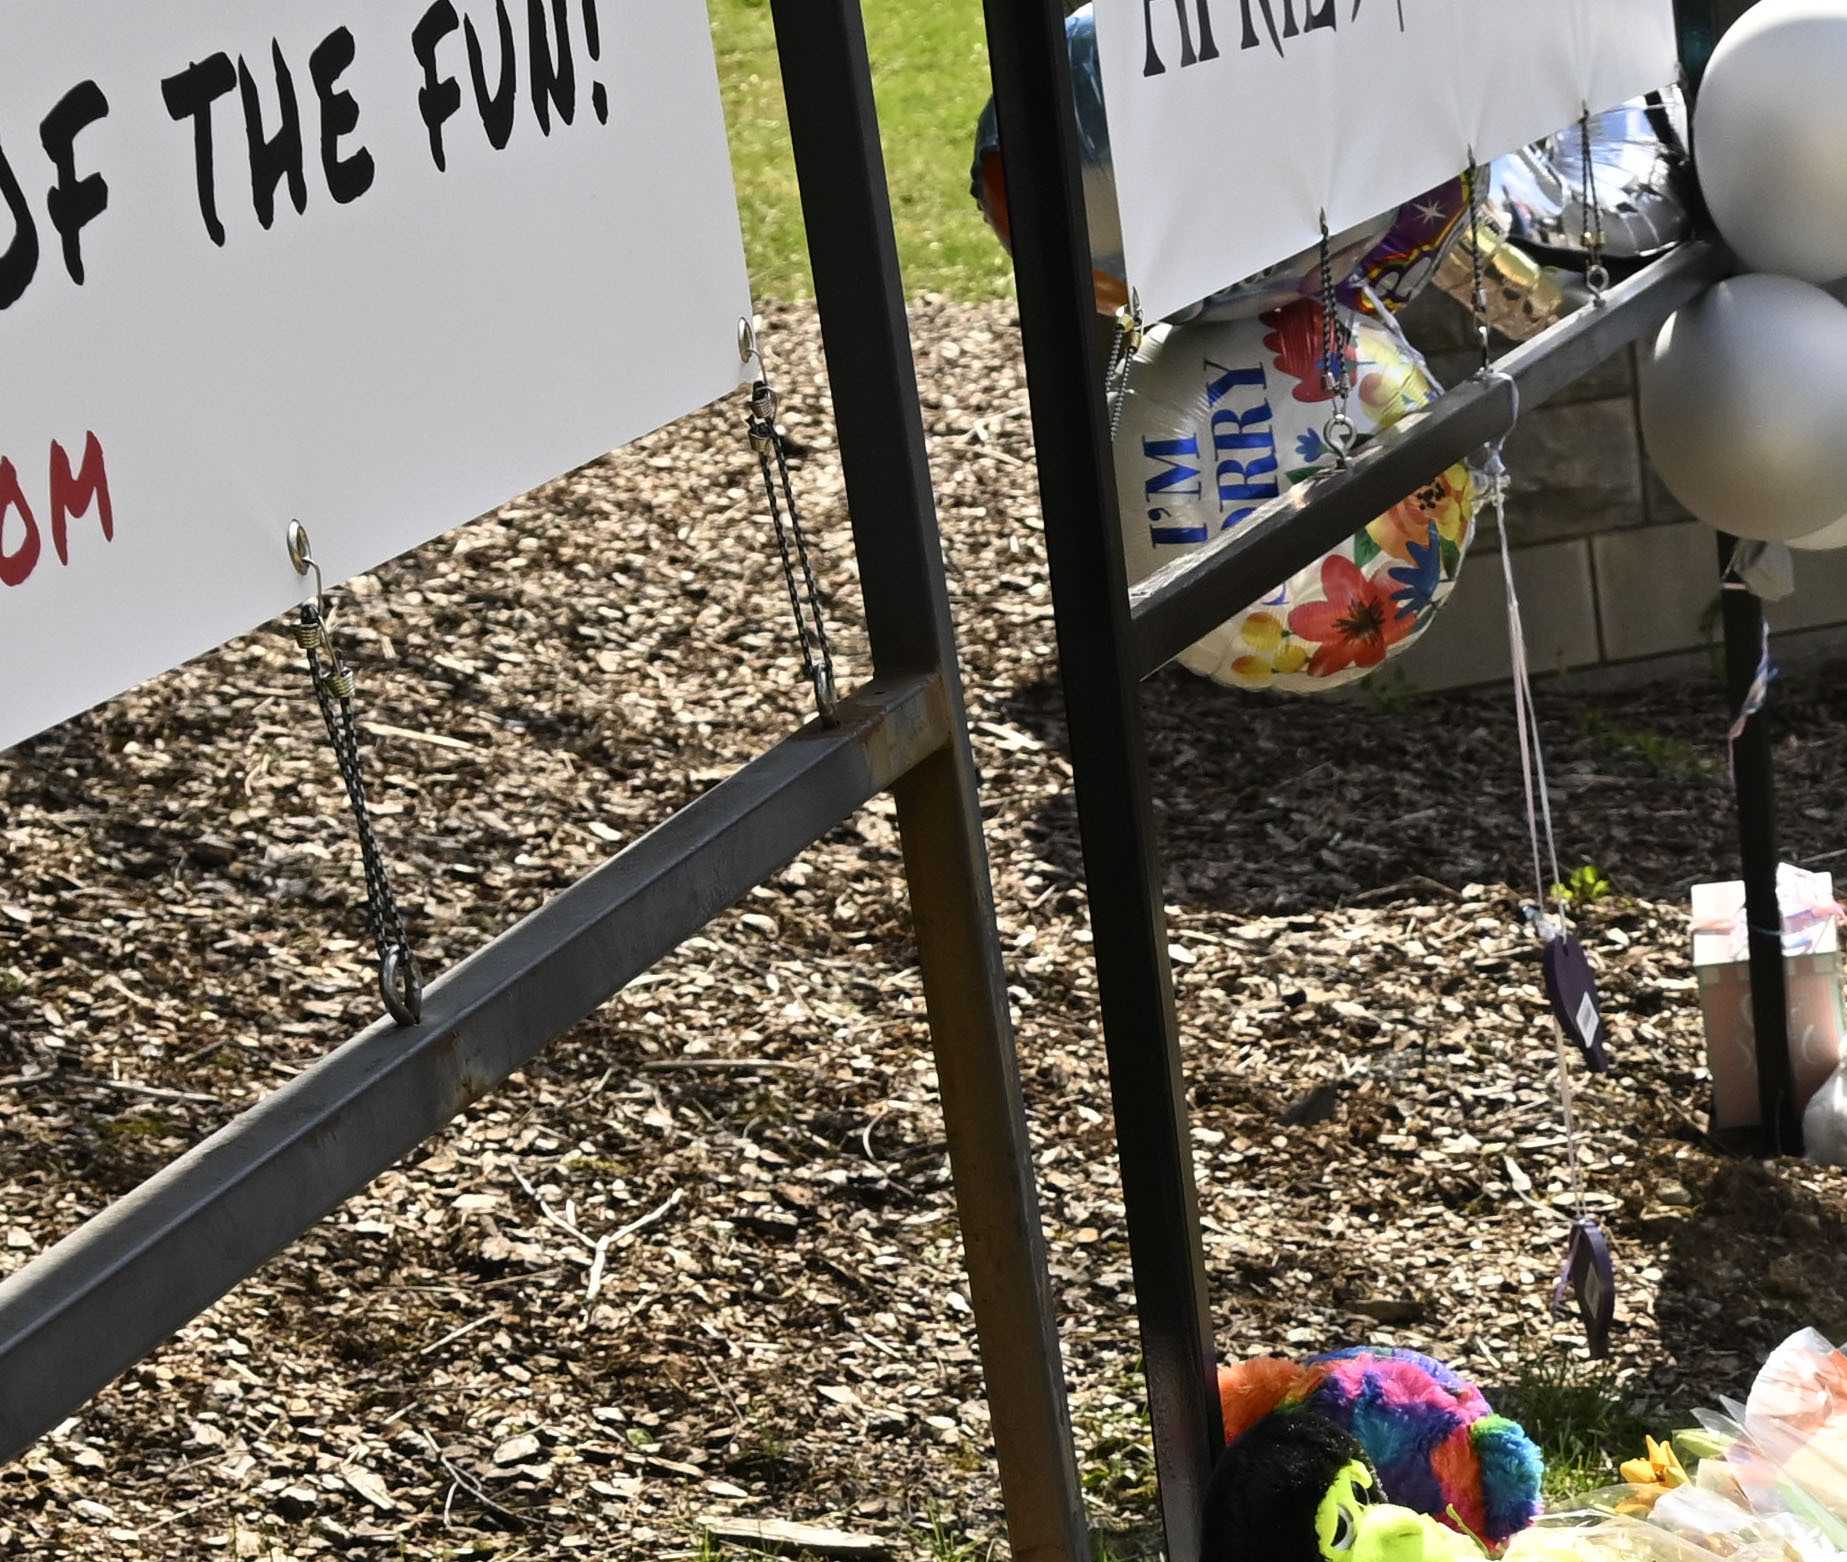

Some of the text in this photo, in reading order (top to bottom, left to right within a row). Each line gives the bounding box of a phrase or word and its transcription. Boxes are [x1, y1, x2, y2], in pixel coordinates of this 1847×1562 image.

[161, 26, 375, 247] THE
[411, 0, 608, 172] FUN!
[1141, 433, 1209, 549] I'M
